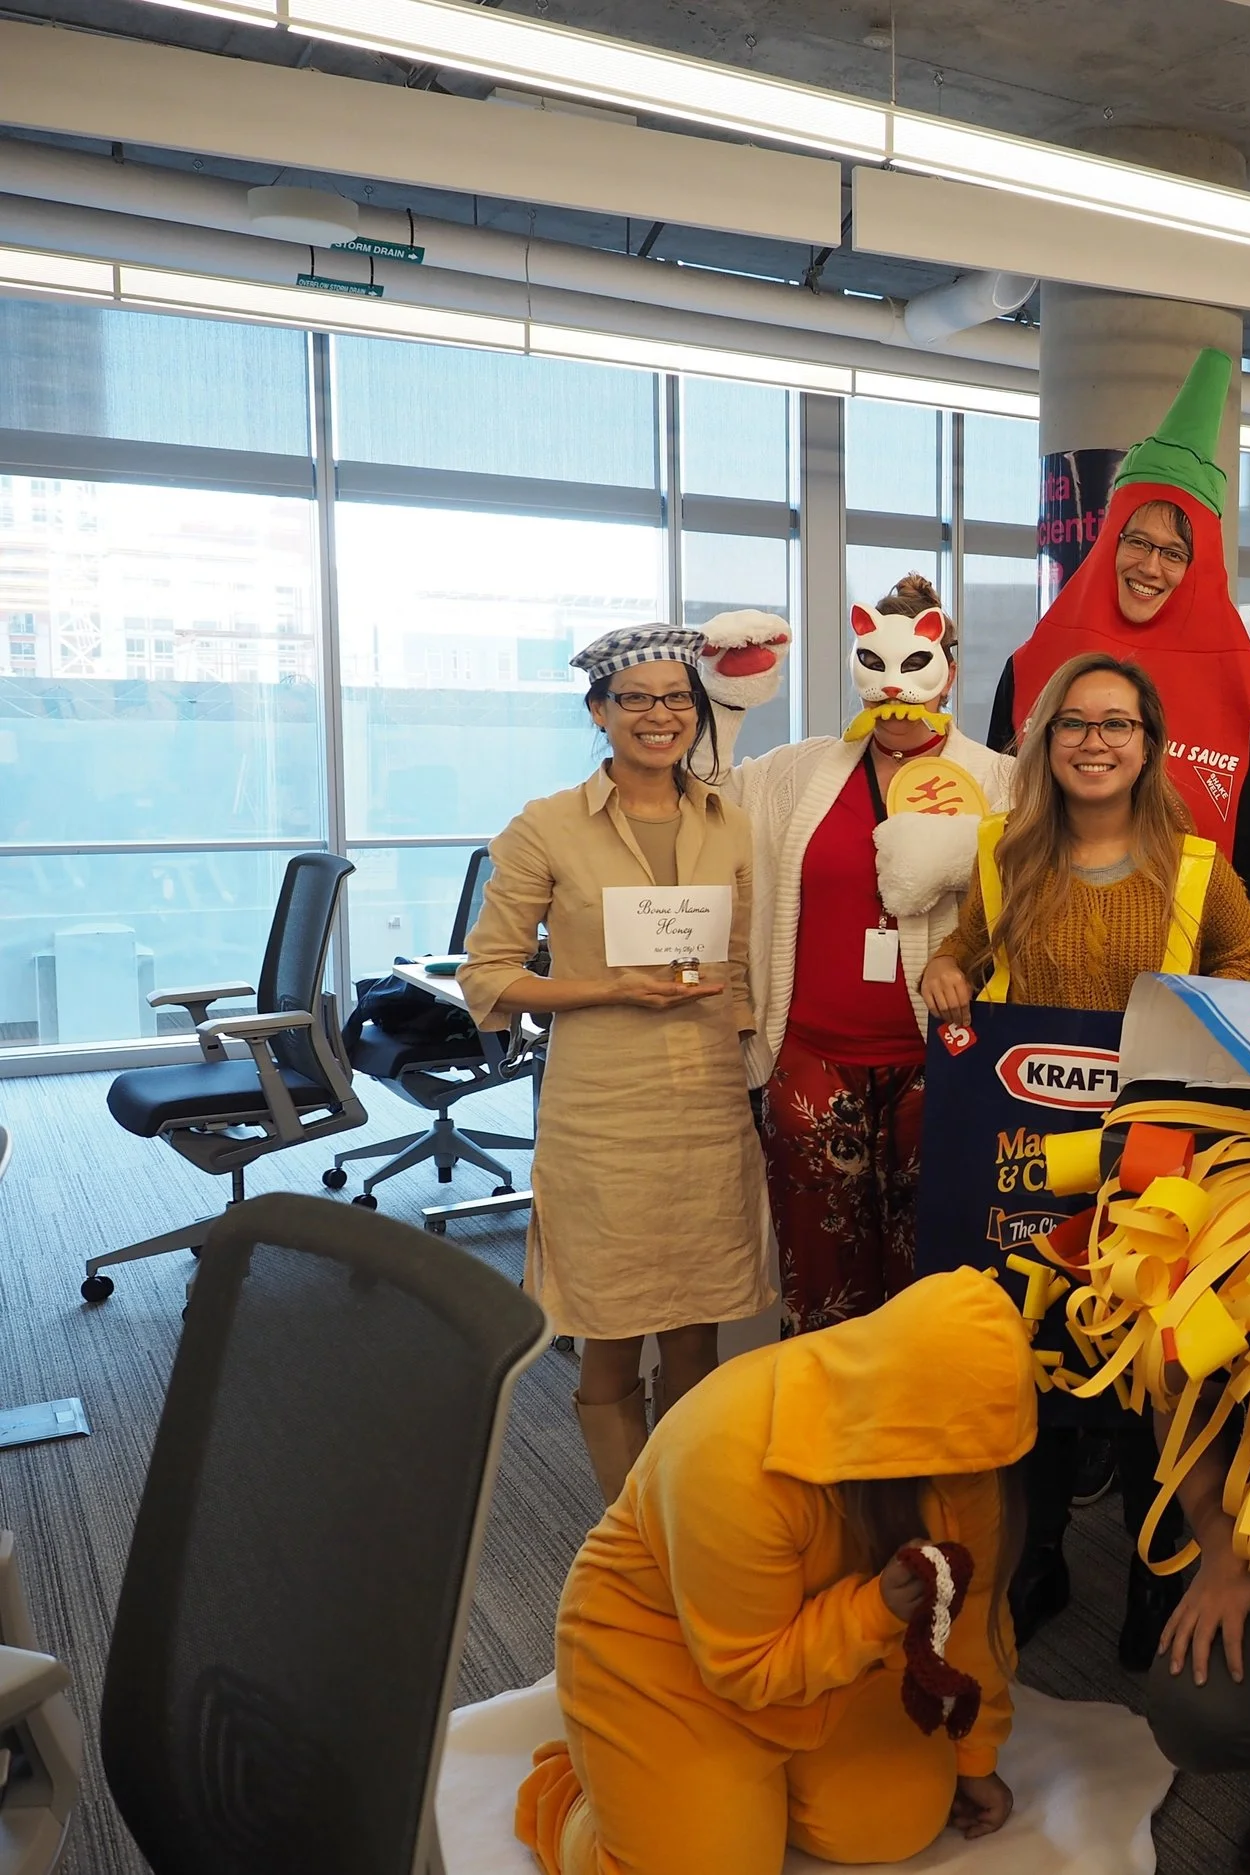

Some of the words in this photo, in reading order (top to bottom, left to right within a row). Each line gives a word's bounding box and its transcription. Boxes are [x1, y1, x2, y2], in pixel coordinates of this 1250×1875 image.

[335, 242, 371, 253] STORM
[373, 245, 405, 258] DRAIN
[298, 278, 329, 290] OVERFLOW
[329, 284, 349, 293] STORM
[349, 287, 367, 295] DRAIN
[1187, 746, 1240, 772] SAUCE
[1206, 778, 1222, 801] WELL
[1210, 773, 1229, 800] SHAKE
[637, 899, 672, 915] Bonne
[675, 899, 710, 915] Maman
[656, 918, 693, 940] Honey
[944, 1023, 970, 1047] $5
[1027, 1061, 1119, 1093] KRAFT
[998, 1165, 1019, 1193] &
[1010, 1220, 1036, 1241] The
